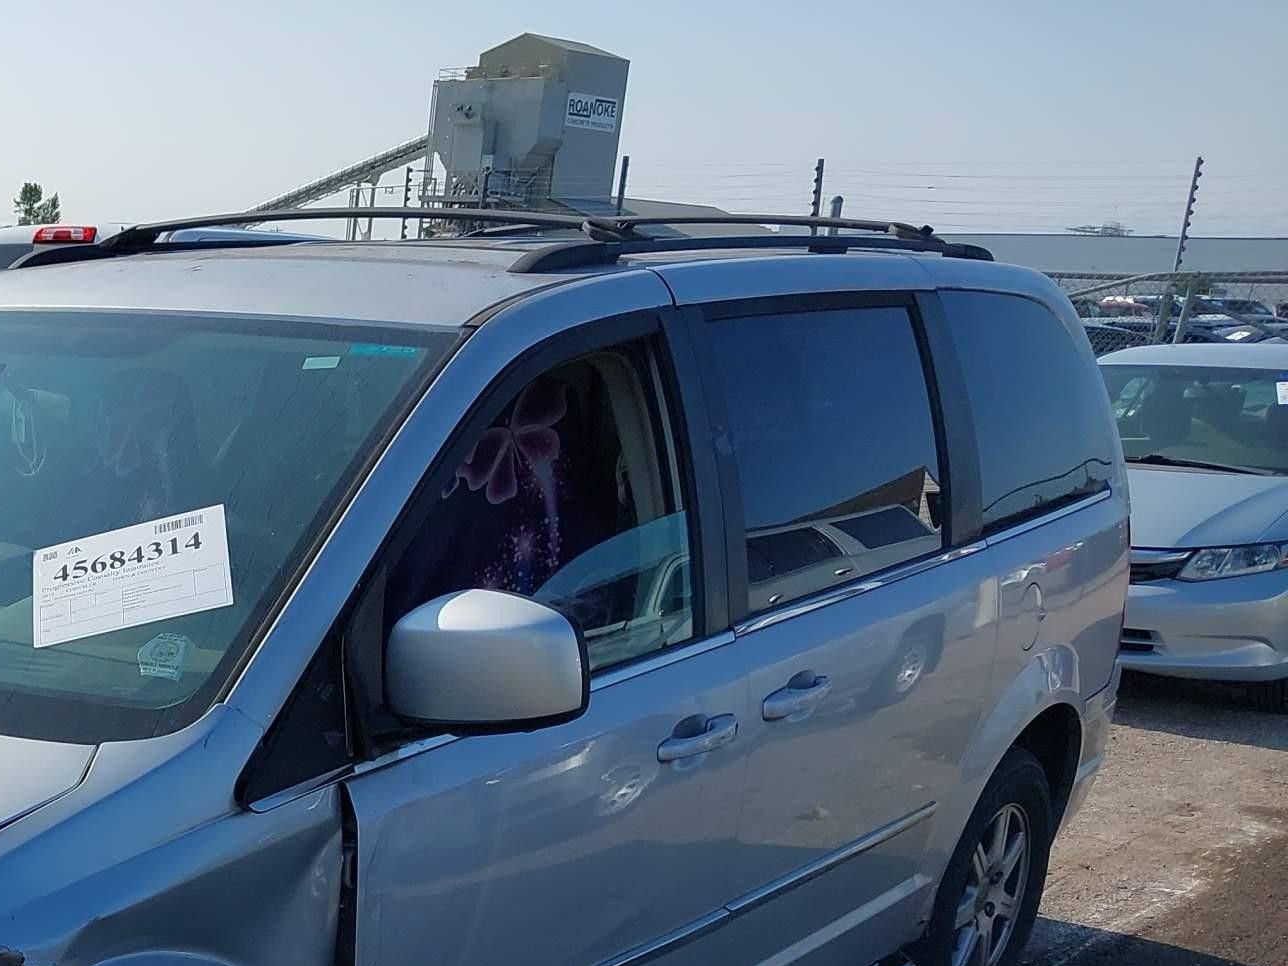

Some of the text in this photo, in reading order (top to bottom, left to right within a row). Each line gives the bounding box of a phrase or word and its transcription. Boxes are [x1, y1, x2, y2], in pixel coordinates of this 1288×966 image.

[568, 98, 616, 118] ROANOKE
[53, 531, 202, 581] 45684314
[41, 578, 86, 593] Progressive
[87, 568, 119, 582] Casualty
